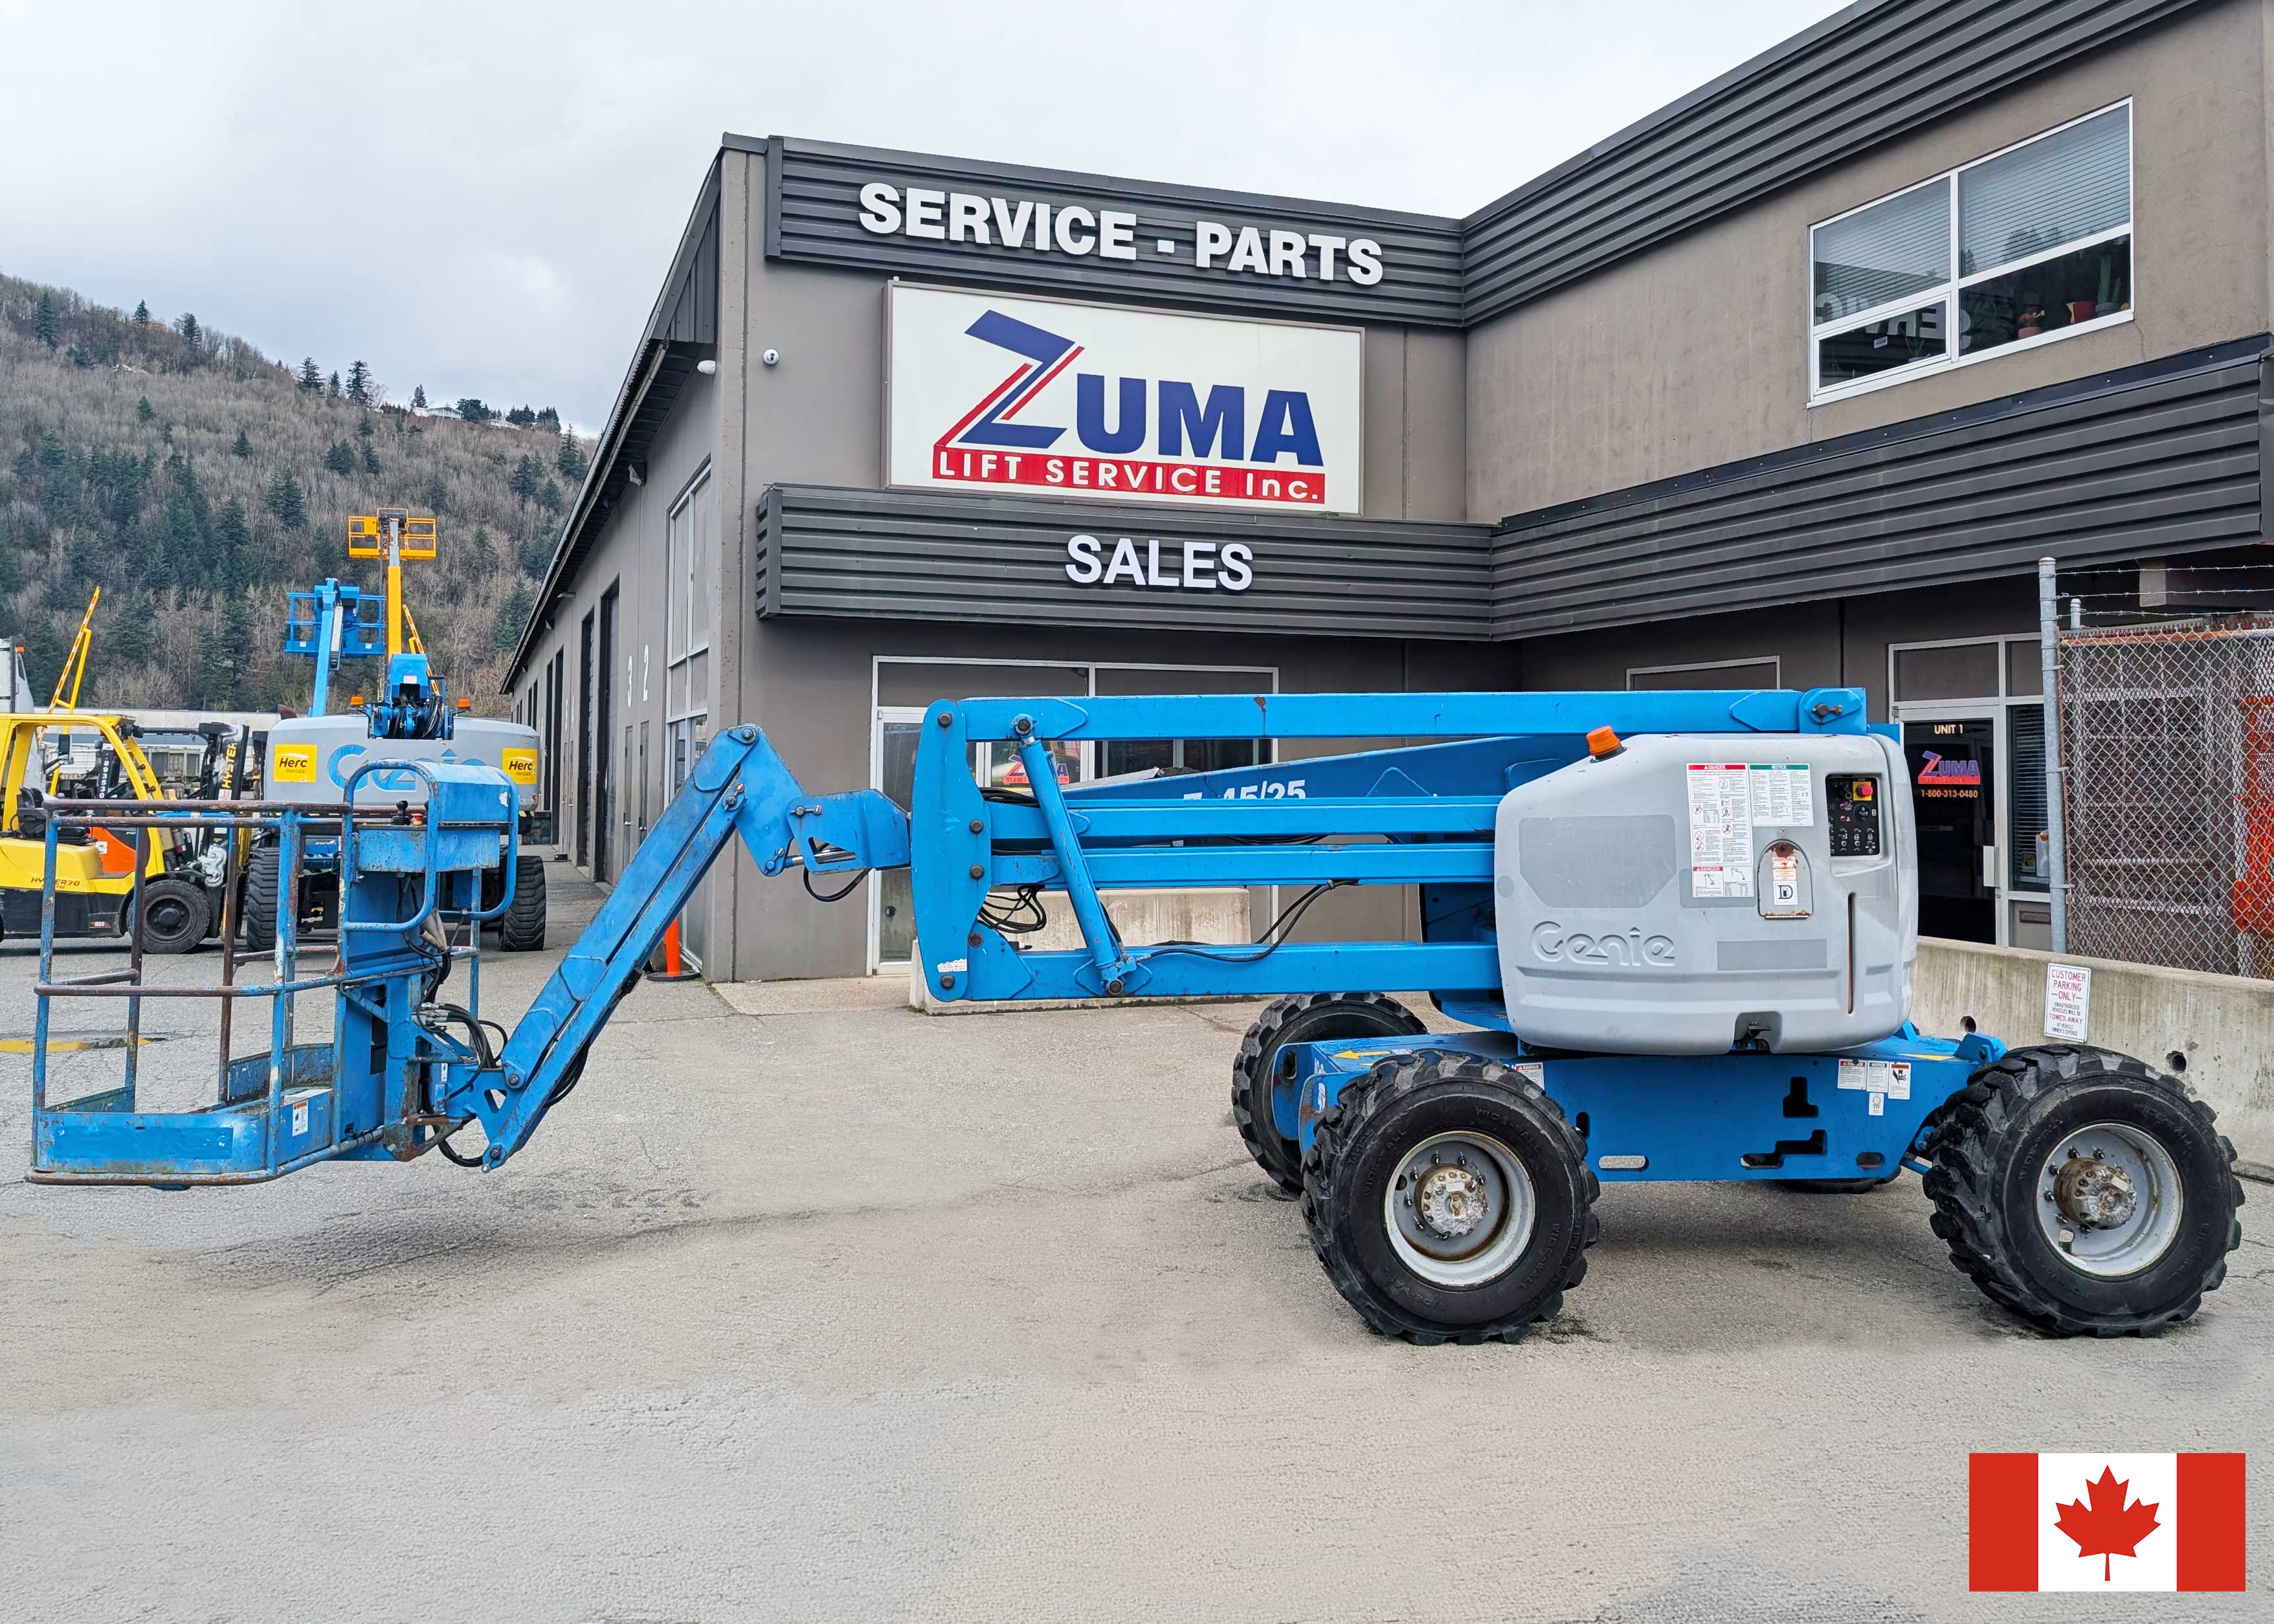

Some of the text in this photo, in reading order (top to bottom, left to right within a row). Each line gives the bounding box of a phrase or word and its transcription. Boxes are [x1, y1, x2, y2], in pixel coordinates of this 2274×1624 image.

[858, 183, 1137, 260] SERVICE
[1196, 221, 1384, 286] PARTS
[934, 309, 1325, 467] ZUMA
[939, 451, 1319, 500] LIFT SERVICE Inc.
[1065, 534, 1253, 591] SALES
[1934, 724, 1963, 734] UNIT 1
[221, 742, 238, 788] HYSTER
[279, 757, 308, 768] Herc
[508, 761, 533, 770] Herc
[1008, 754, 1069, 777] ZA
[1920, 750, 1980, 777] ZUMA
[31, 877, 67, 885] HYER
[1778, 885, 1793, 900] D
[1532, 921, 1676, 966] Genie
[2051, 969, 2086, 982] CUSTOMER
[2053, 980, 2082, 992] PARKING
[2058, 991, 2076, 1001] ONLY
[2049, 1013, 2083, 1024] TOWED AWAY
